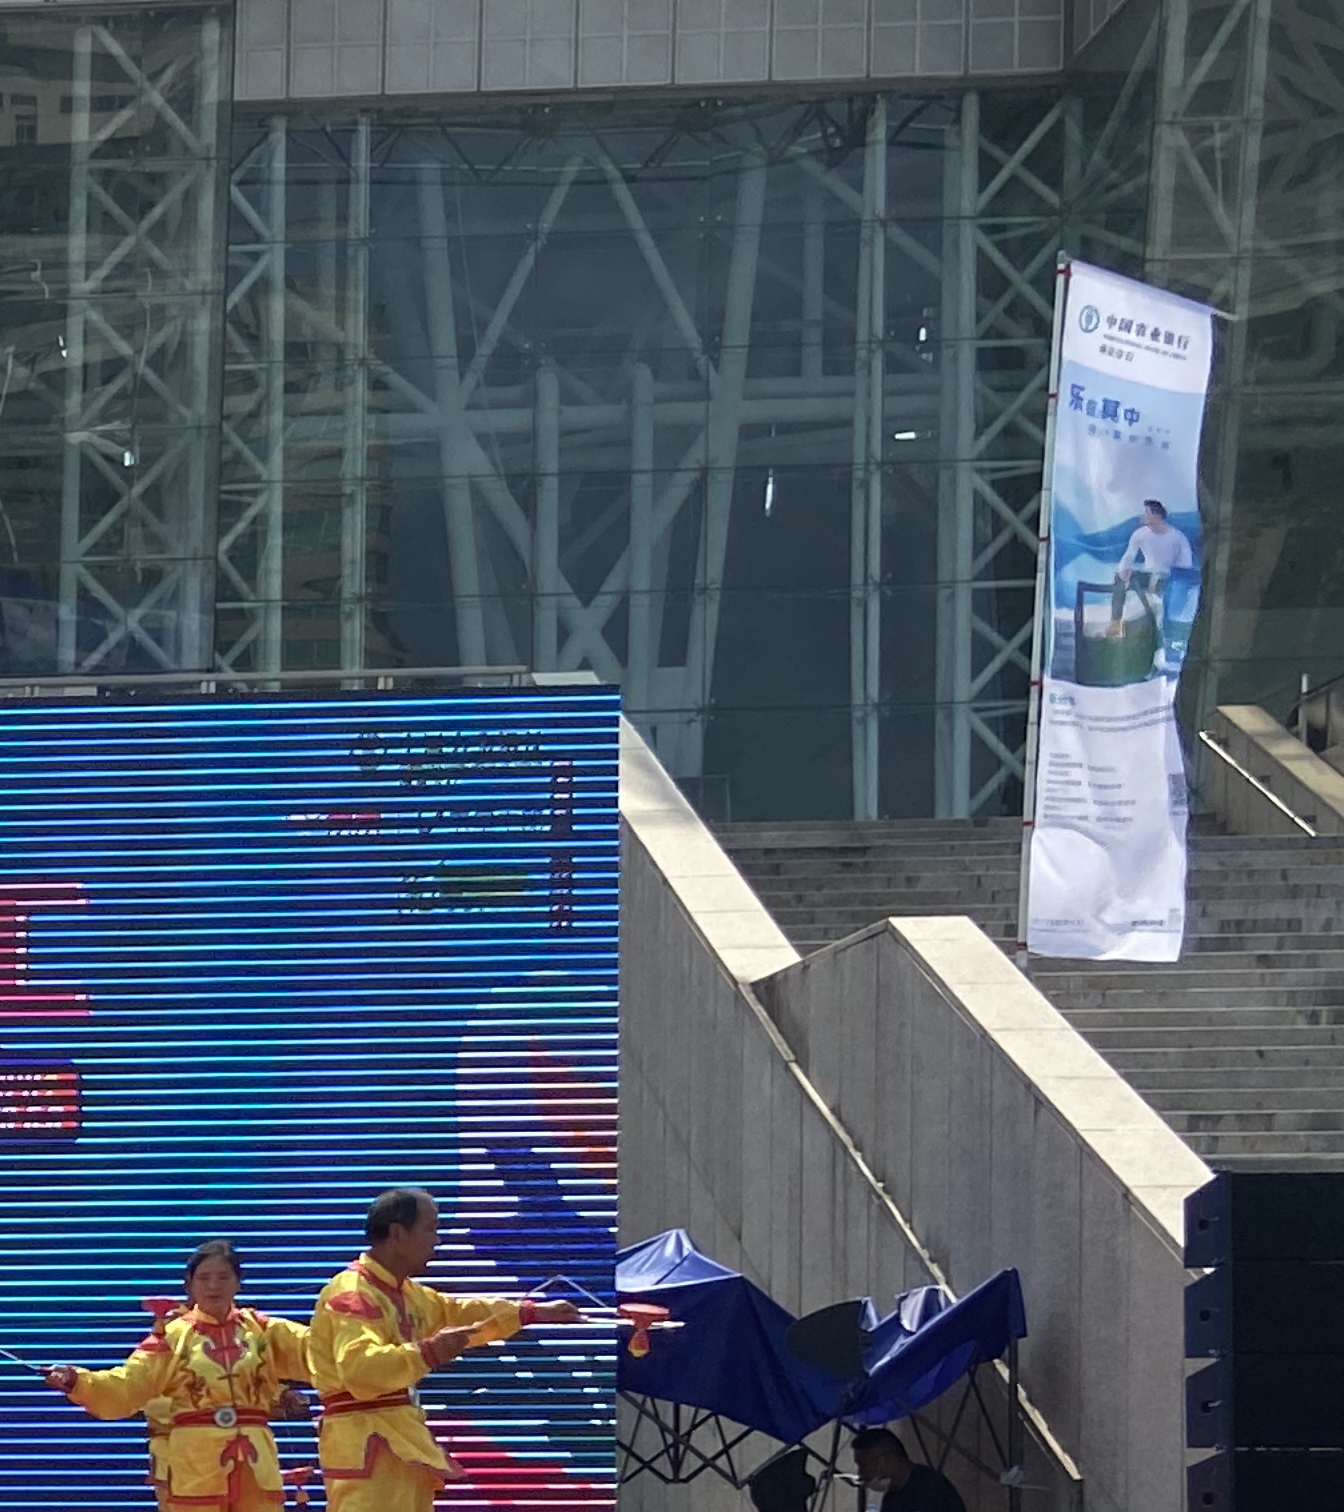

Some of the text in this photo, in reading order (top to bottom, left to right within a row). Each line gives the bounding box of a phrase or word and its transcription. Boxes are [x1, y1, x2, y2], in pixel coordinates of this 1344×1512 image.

[1106, 314, 1191, 351] 中国农业银行
